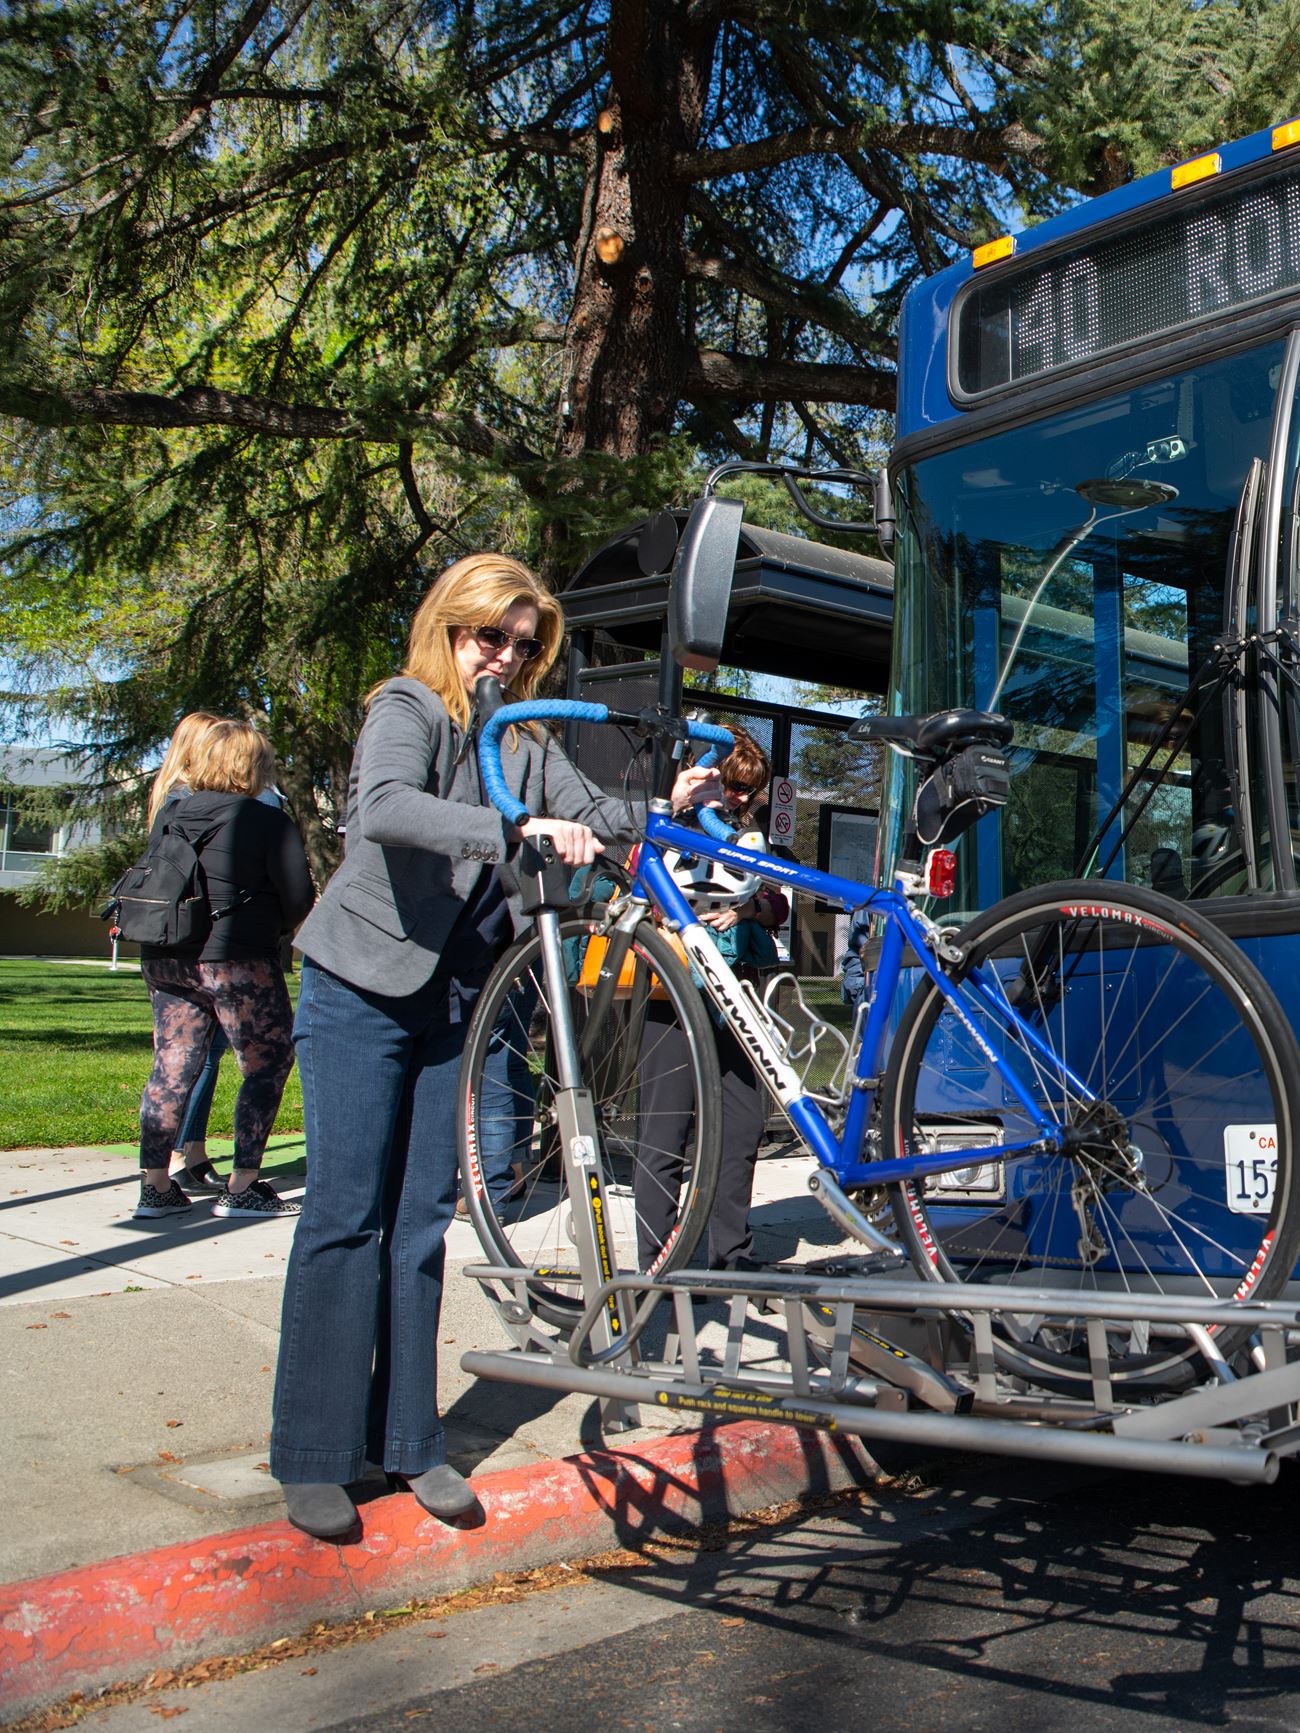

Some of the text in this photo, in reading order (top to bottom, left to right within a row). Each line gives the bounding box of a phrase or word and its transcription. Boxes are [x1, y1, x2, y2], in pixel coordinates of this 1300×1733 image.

[1016, 257, 1099, 369] 40
[986, 756, 1005, 766] GIANT
[717, 847, 798, 876] SUPER SPORT
[1069, 906, 1174, 941] VELOMAX CIRCUIT
[690, 945, 788, 1091] SCHWINN
[467, 1124, 483, 1192] VELOMAX
[597, 1224, 606, 1244] hook
[600, 1245, 608, 1259] out
[602, 1260, 611, 1275] and
[678, 1395, 817, 1422] Push rack and squeeze handle to lower
